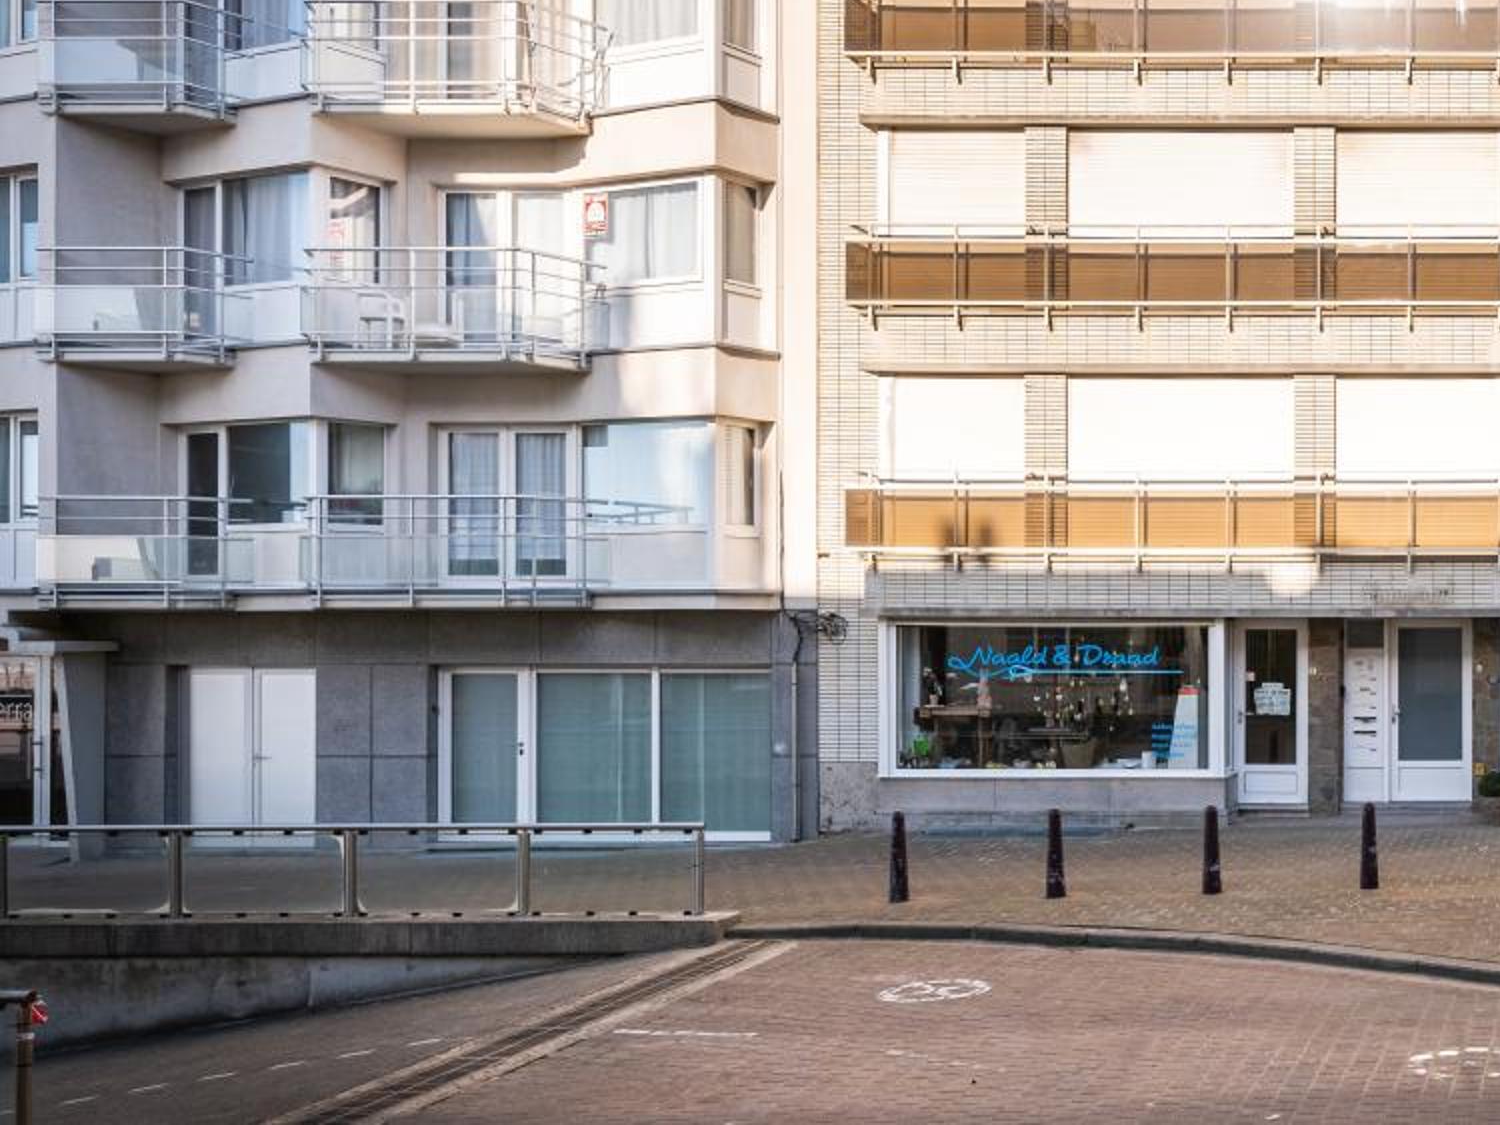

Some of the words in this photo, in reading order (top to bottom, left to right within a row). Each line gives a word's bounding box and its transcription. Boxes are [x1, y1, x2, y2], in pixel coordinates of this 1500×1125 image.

[948, 643, 1048, 670] Naald
[1052, 644, 1071, 666] &
[1076, 643, 1160, 667] Draad
